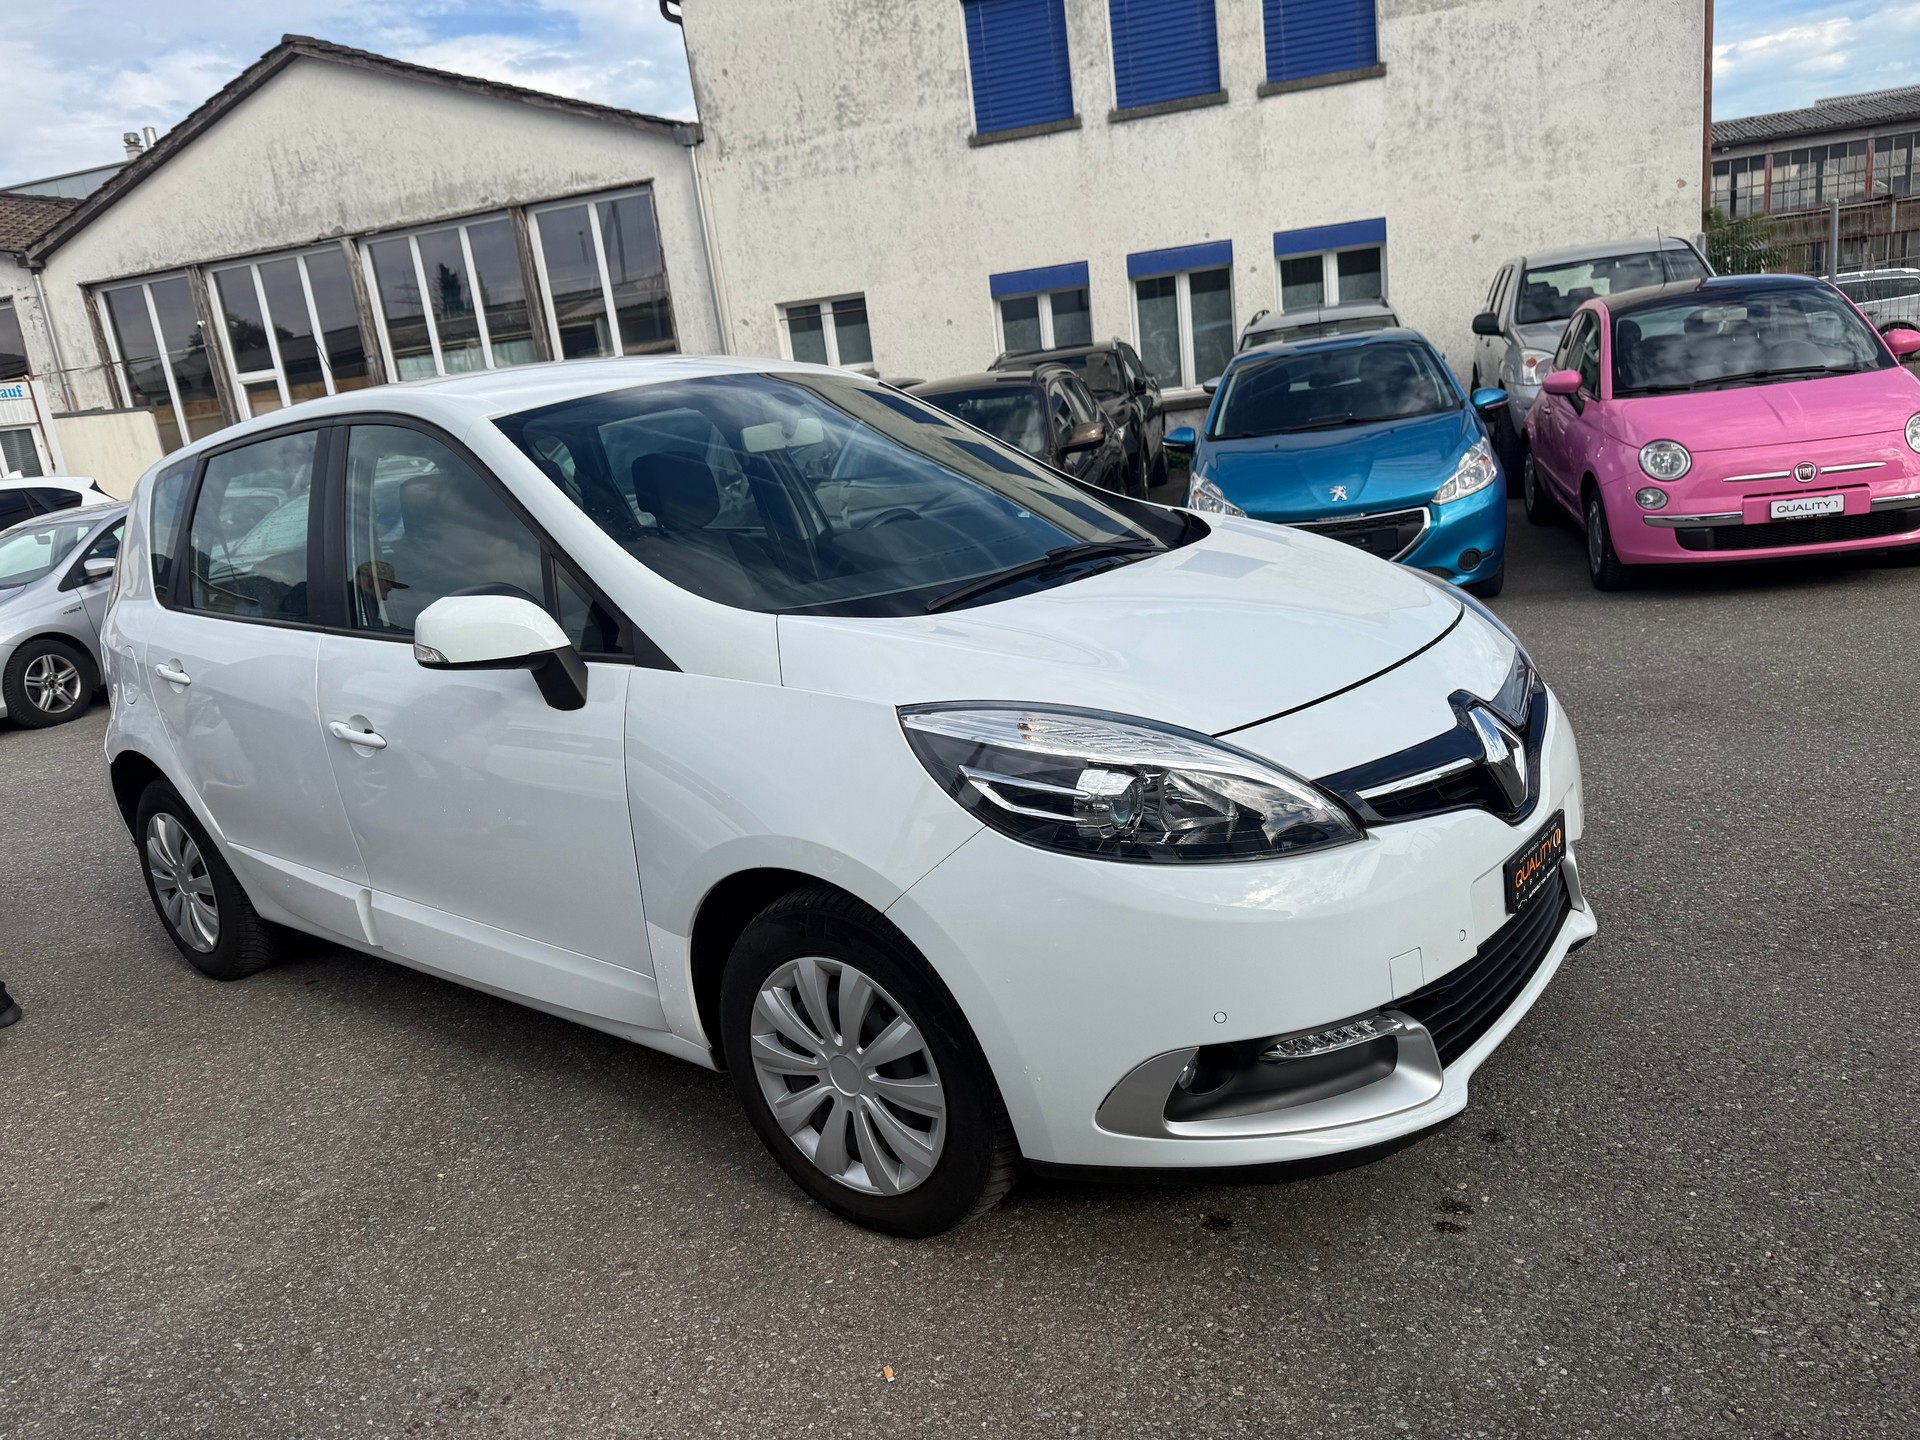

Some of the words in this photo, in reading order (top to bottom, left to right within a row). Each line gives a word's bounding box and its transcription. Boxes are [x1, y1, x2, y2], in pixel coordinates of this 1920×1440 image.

[1799, 467, 1812, 477] FIAT
[1777, 501, 1831, 513] QUALITY
[1516, 836, 1553, 888] QUALITY
